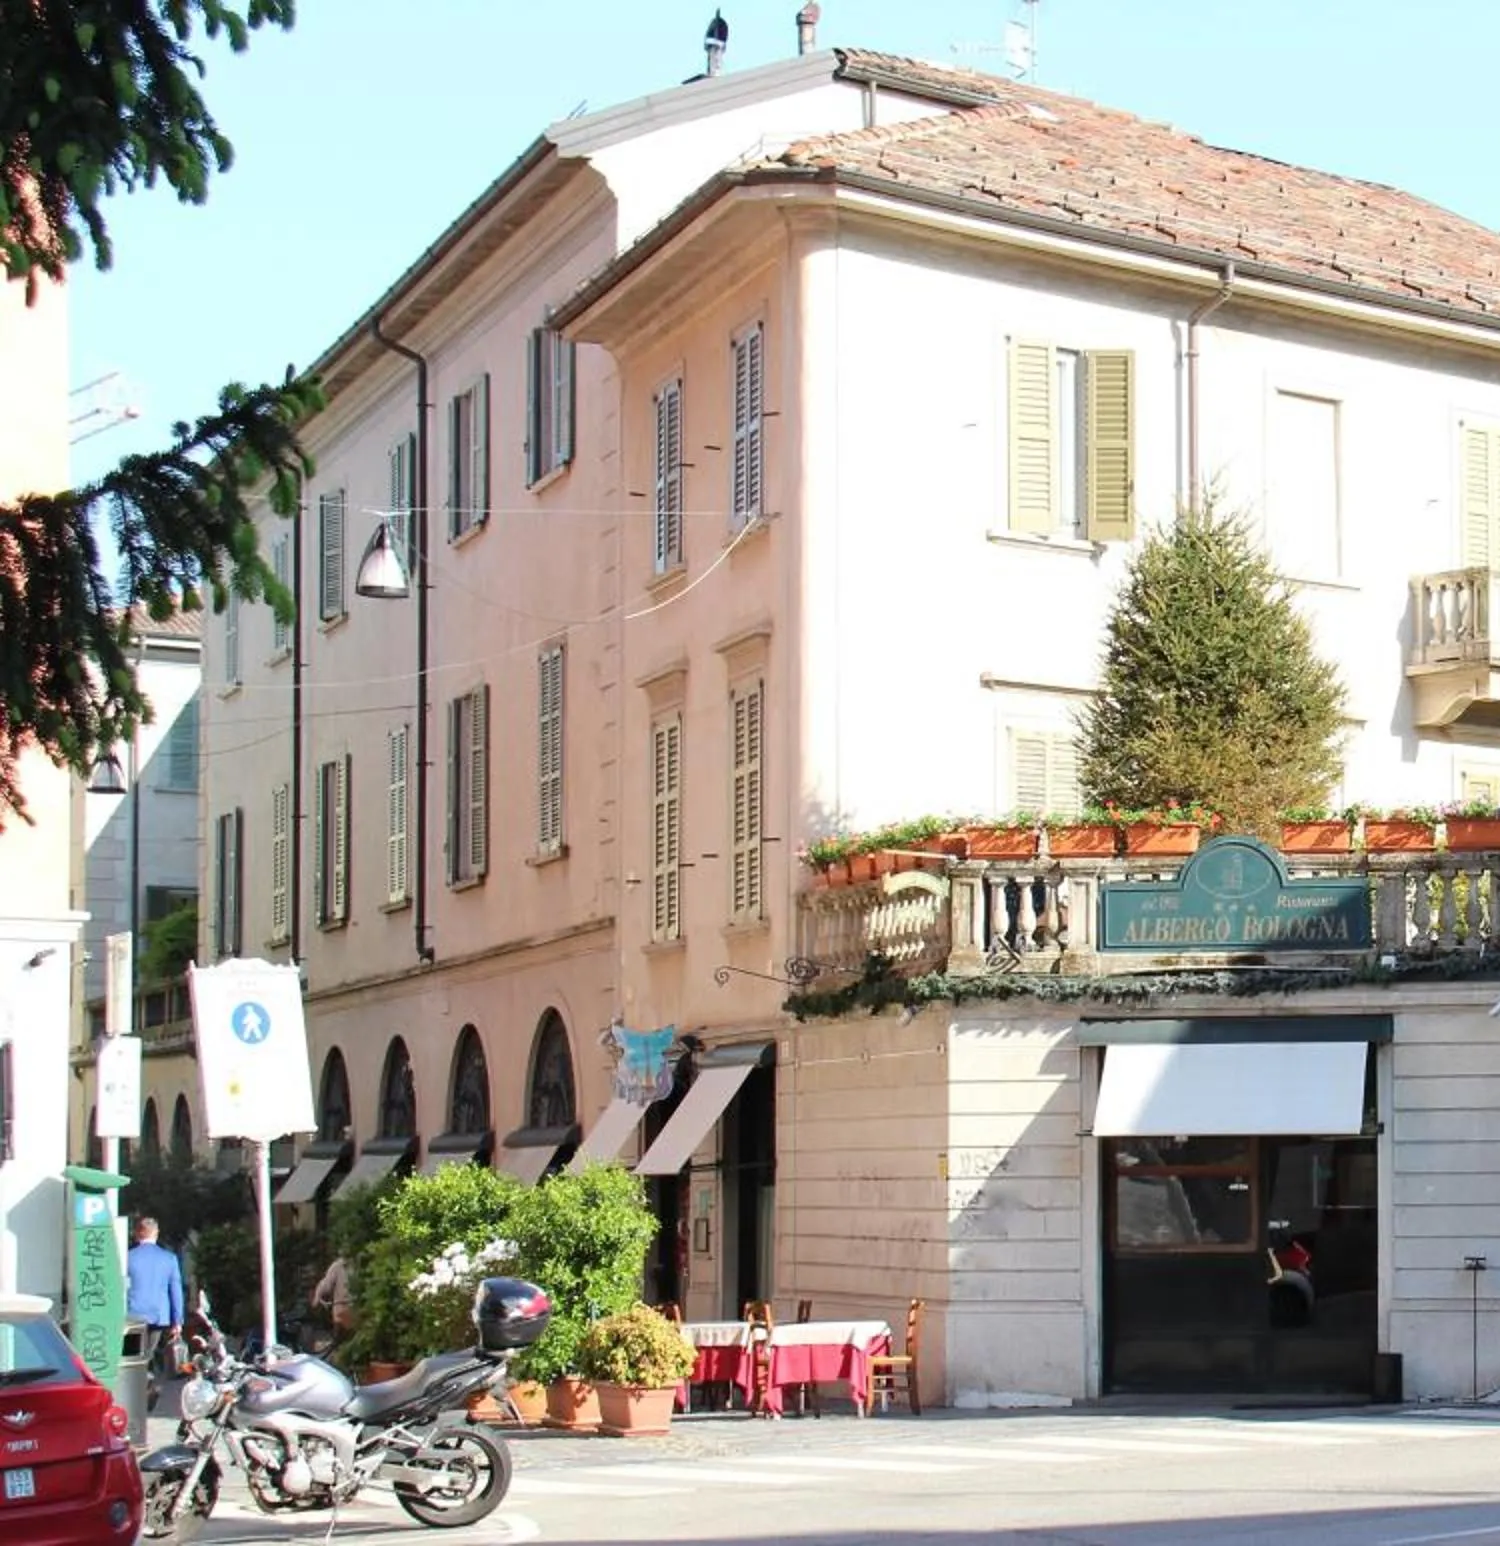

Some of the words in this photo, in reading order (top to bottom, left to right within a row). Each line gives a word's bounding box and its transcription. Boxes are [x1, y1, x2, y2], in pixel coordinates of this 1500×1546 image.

[1123, 916, 1231, 943] ALBERGO
[1243, 914, 1349, 941] BOLOGNA
[83, 1198, 106, 1226] P
